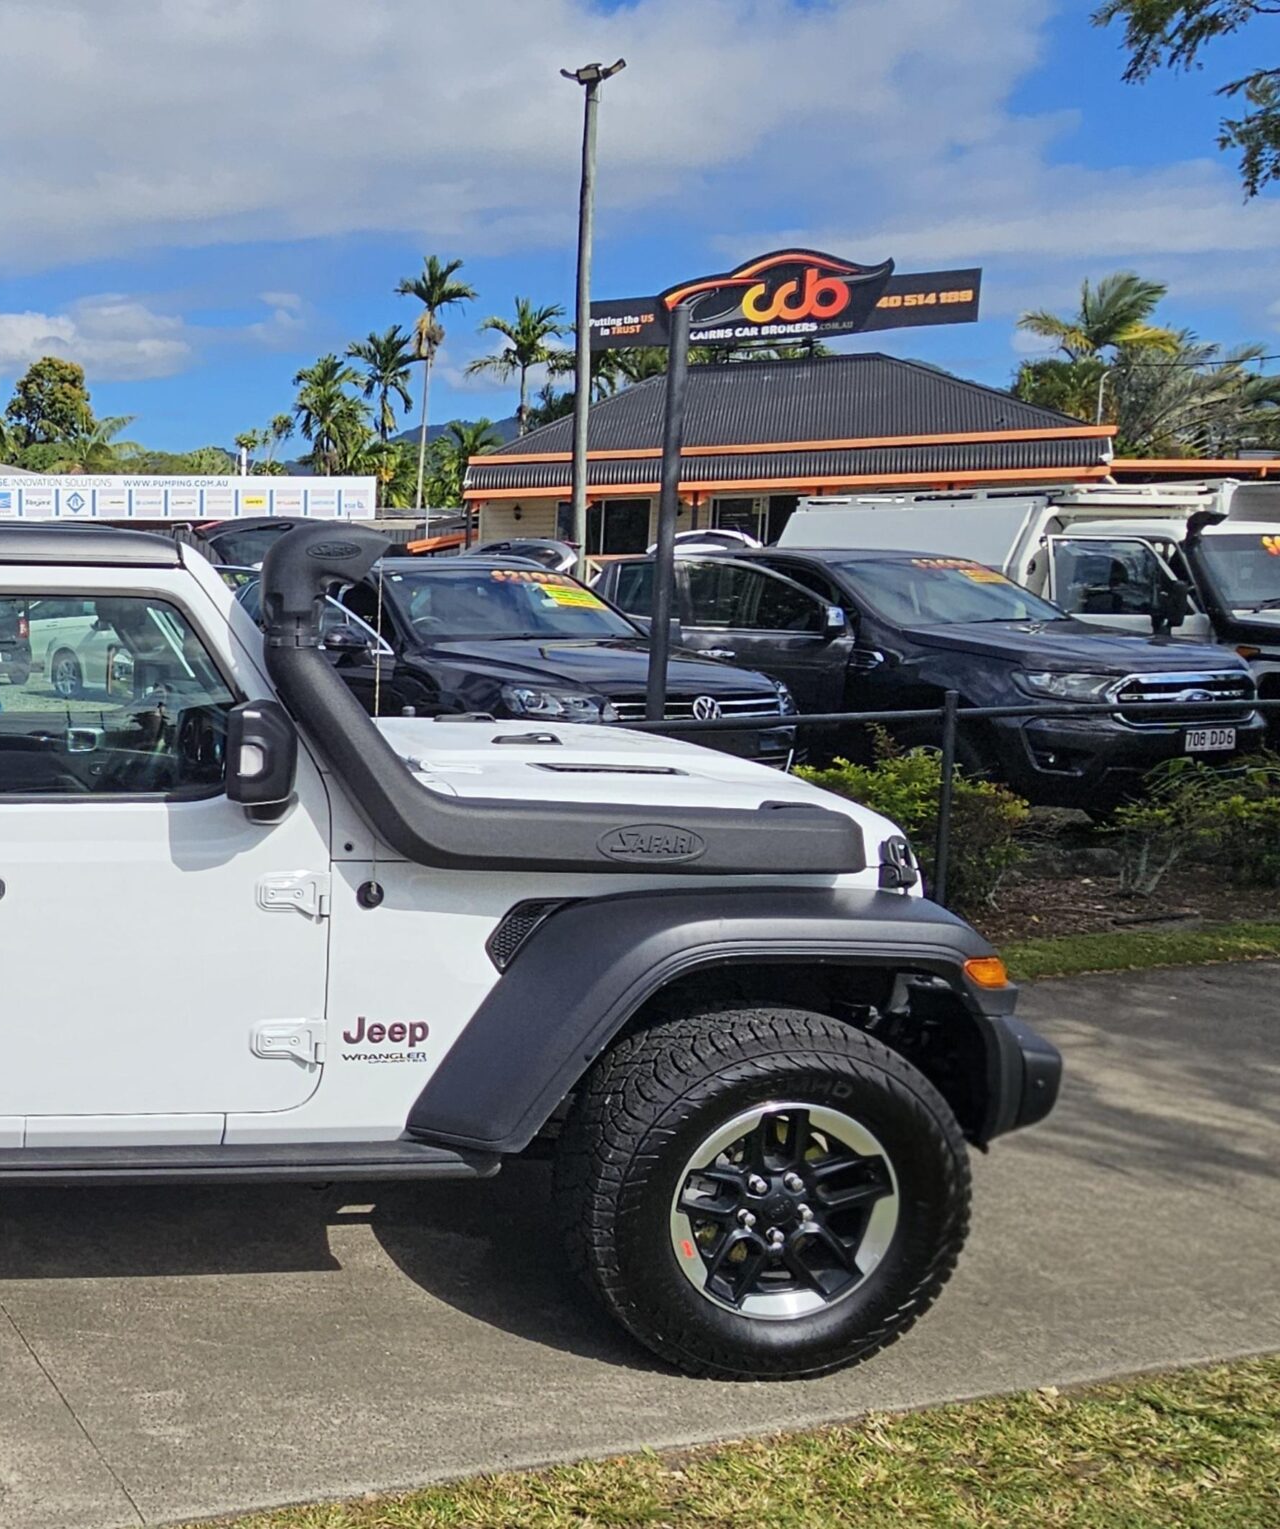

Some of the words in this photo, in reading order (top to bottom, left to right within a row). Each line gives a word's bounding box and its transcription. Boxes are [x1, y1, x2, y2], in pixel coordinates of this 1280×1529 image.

[876, 295, 902, 308] 40
[903, 292, 936, 306] 514
[588, 315, 622, 328] Putting
[623, 314, 639, 324] the
[640, 313, 655, 323] US
[600, 327, 610, 336] in
[611, 324, 642, 335] TRUST
[689, 327, 733, 340] CAIRNS
[735, 325, 758, 337] CAR
[65, 478, 112, 487] SOLUTIONS
[123, 479, 228, 488] WWW.PUMPING.COM.AU
[1186, 731, 1207, 747] 708
[1210, 730, 1234, 746] DD6
[610, 832, 696, 854] SAFARI
[343, 1016, 429, 1048] Jeep
[342, 1051, 427, 1062] WRANGLER
